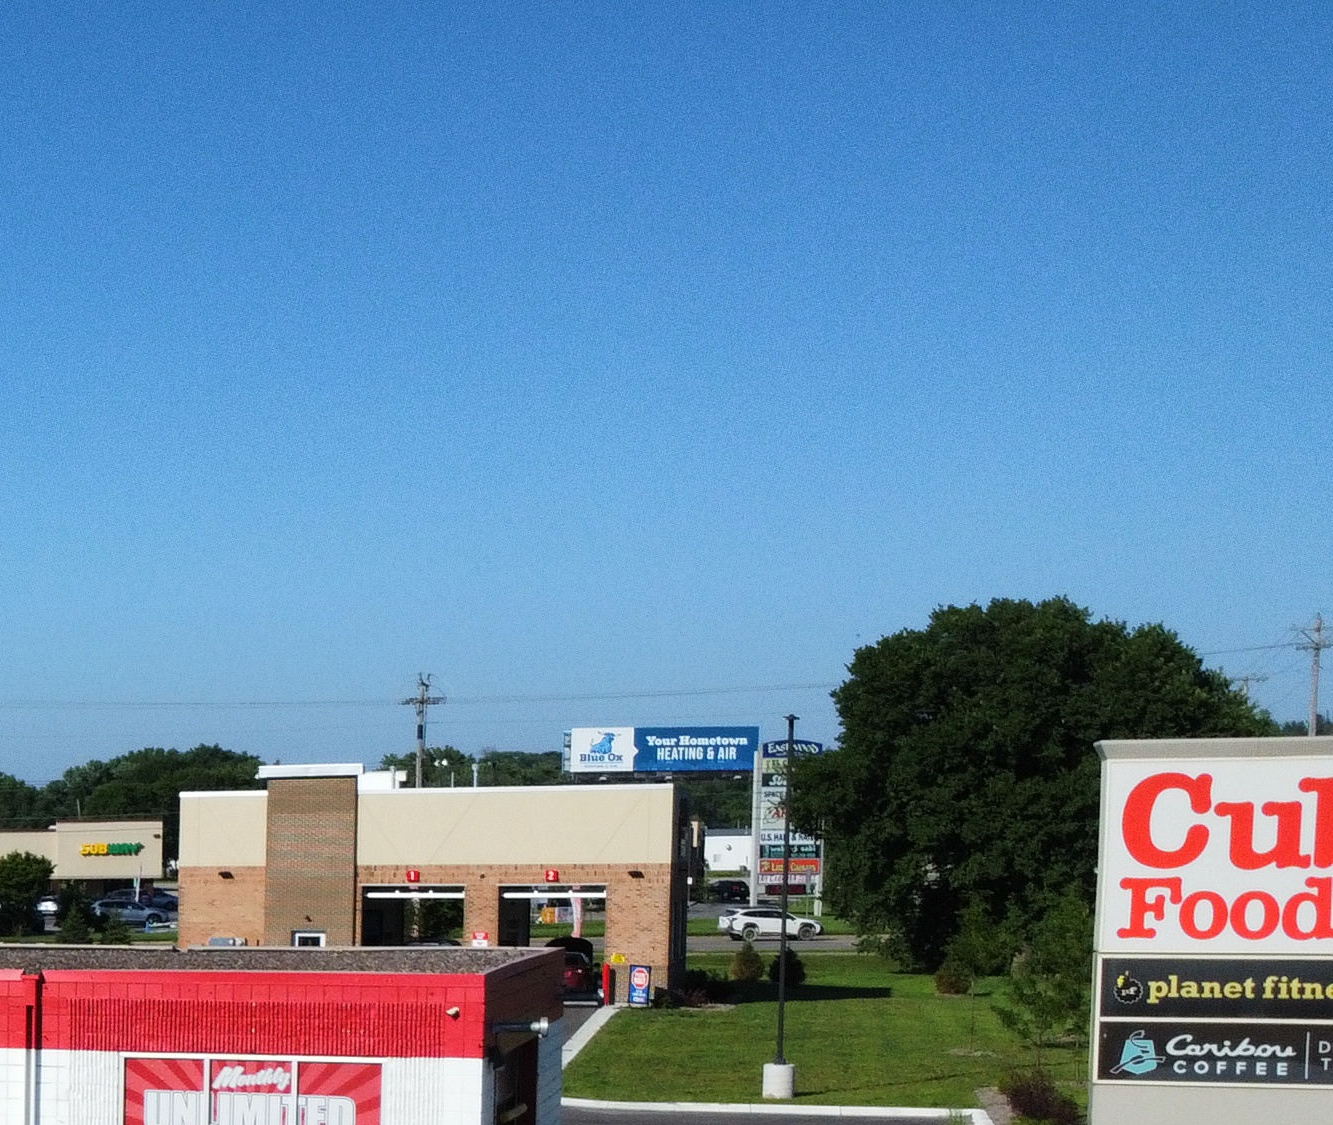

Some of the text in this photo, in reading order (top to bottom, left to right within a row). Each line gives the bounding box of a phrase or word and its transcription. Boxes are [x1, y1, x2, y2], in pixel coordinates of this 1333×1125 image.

[646, 735, 748, 746] Your Hometown
[580, 753, 623, 762] Blue Ox
[657, 746, 737, 760] HEATING & AIR
[80, 843, 144, 856] SUBWAY
[409, 870, 415, 880] 1
[548, 870, 555, 880] 2
[1147, 975, 1255, 1004] planet
[1166, 1034, 1297, 1057] Caribou
[1173, 1061, 1288, 1076] COFFEE
[212, 1066, 290, 1090] Monthly
